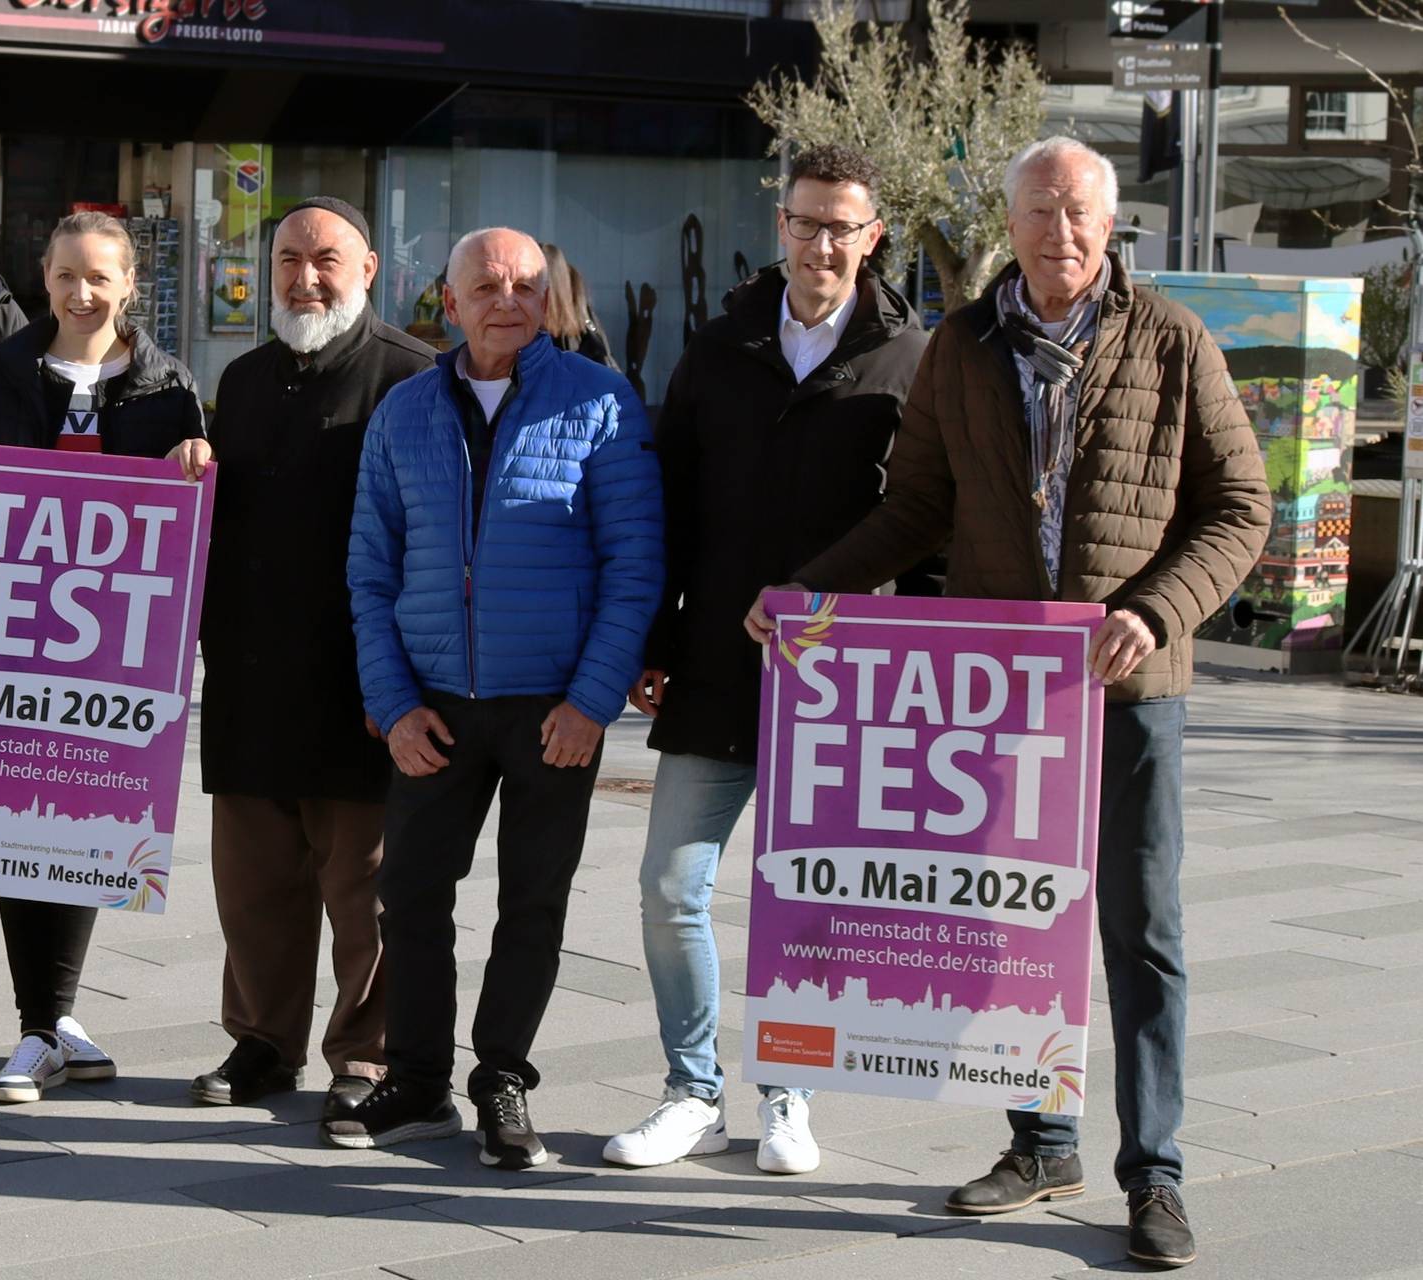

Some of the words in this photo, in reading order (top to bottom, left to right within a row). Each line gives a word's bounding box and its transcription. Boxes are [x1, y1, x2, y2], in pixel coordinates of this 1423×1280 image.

[795, 645, 1063, 731] STADT
[60, 691, 155, 733] 2026
[46, 740, 59, 758] &
[63, 743, 109, 763] Enste
[789, 722, 1066, 841] FEST
[0, 840, 50, 854] Stadtmarketing
[52, 846, 85, 857] Meschede
[47, 864, 138, 890] Meschede
[790, 857, 849, 897] 10.
[861, 861, 938, 904] Mai
[950, 869, 1056, 913] 2026
[830, 916, 930, 941] Innenstadt
[937, 924, 951, 943] &
[956, 926, 1008, 948] Enste
[782, 942, 1055, 979] www.meschede.de/stadtfest
[773, 1038, 803, 1047] Sparkasse
[846, 1032, 892, 1044] Veranstalter:
[893, 1035, 950, 1051] Stadtmarketing
[951, 1042, 988, 1053] Meschede
[861, 1053, 939, 1078] VELTINS
[949, 1062, 1051, 1090] Meschede
